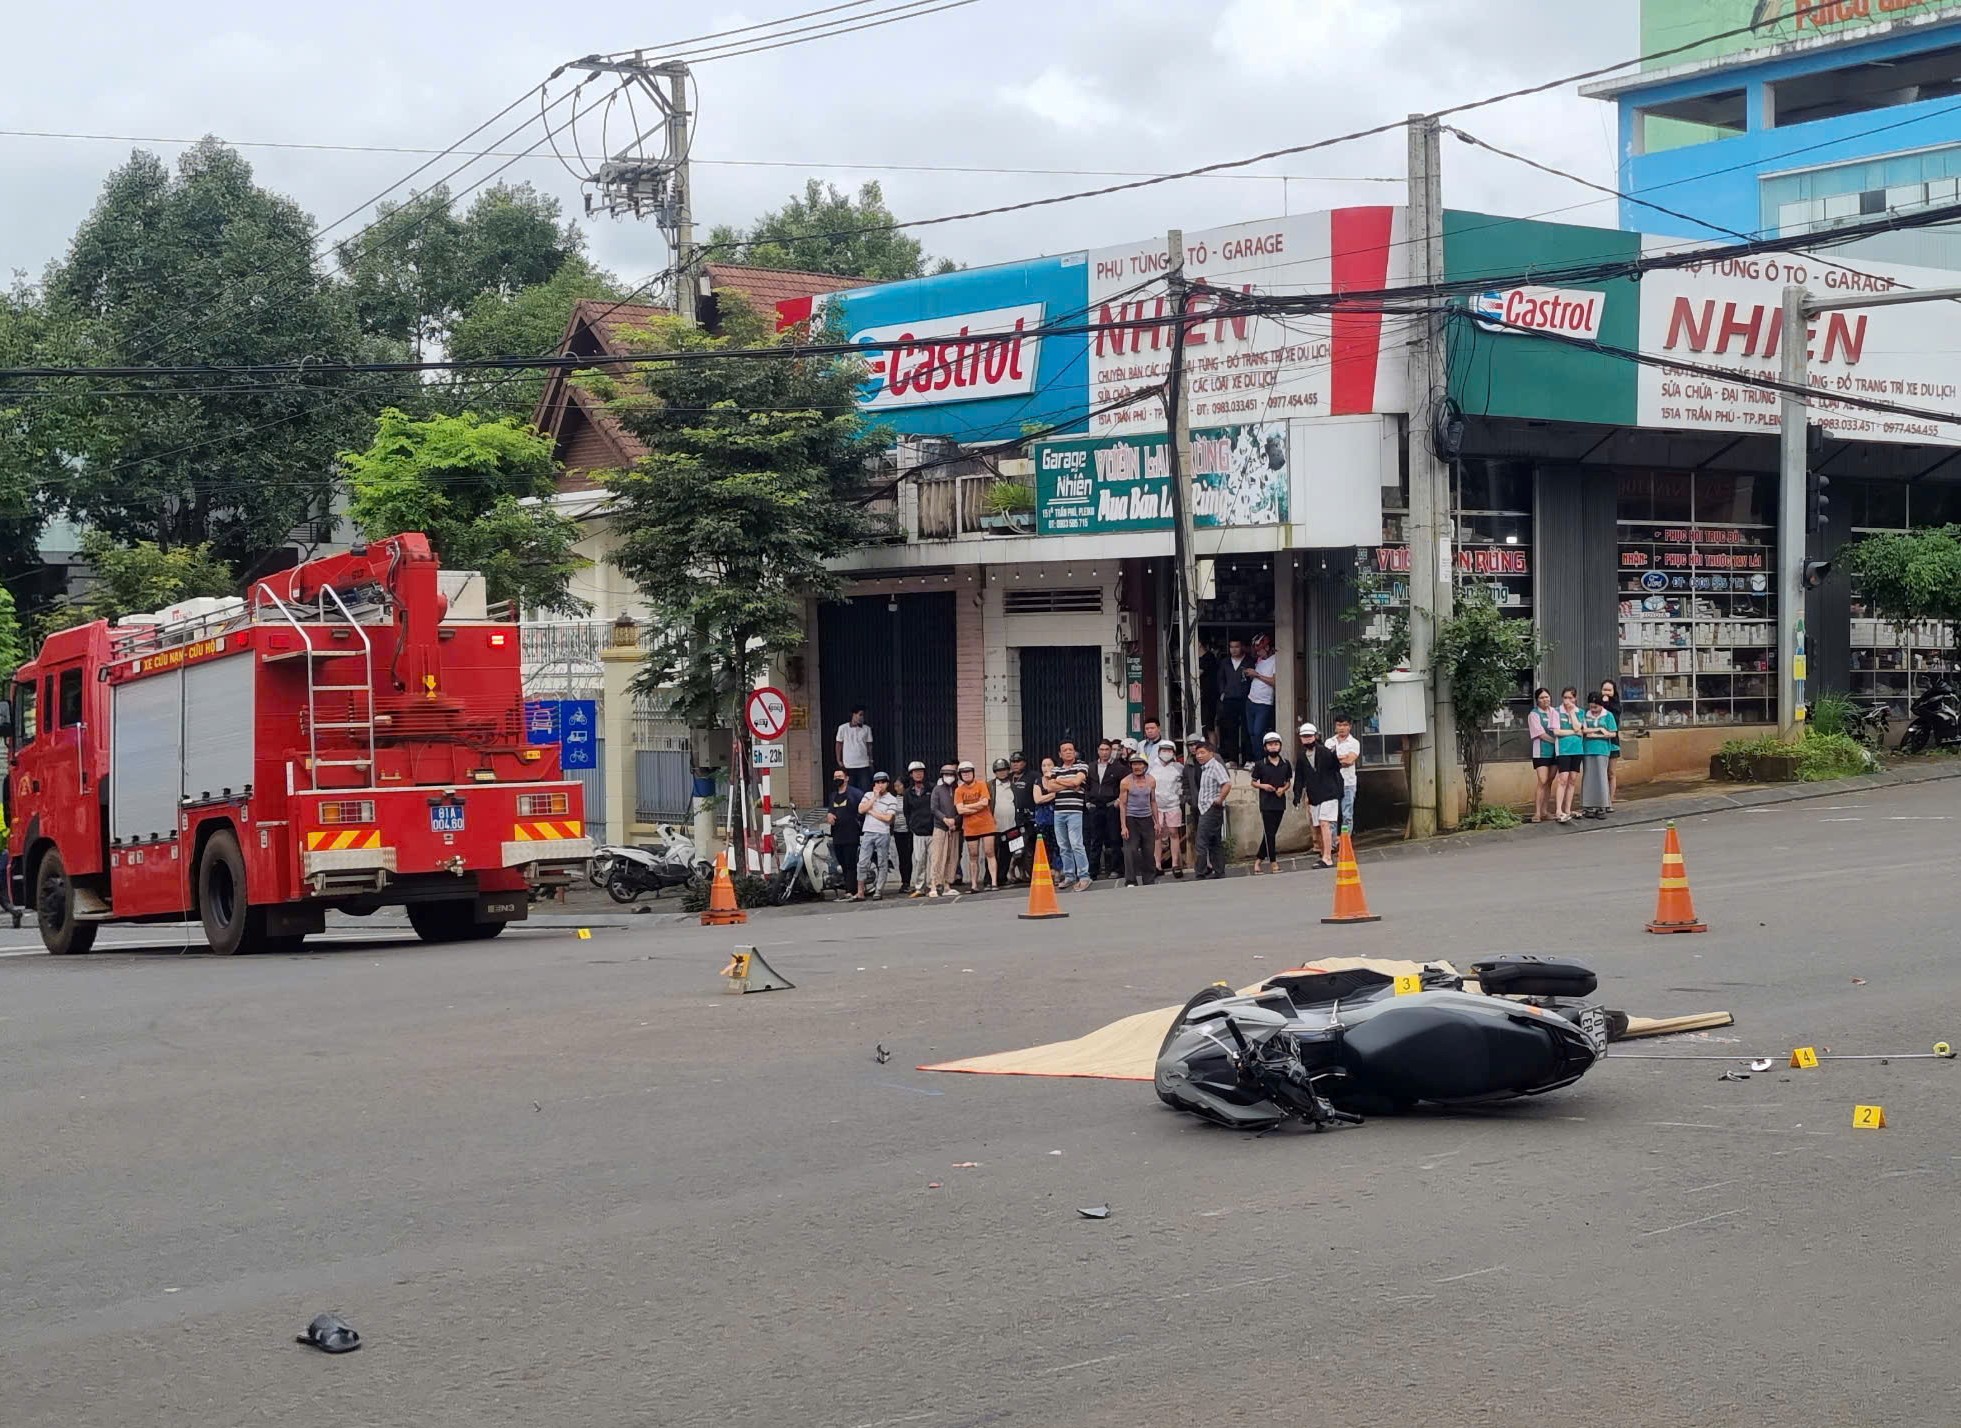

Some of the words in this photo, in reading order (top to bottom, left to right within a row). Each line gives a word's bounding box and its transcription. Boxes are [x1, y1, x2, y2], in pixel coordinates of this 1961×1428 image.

[1097, 261, 1123, 281] PHỤ
[1222, 233, 1284, 261] GARAGE
[1825, 270, 1895, 293] GARAGE
[1505, 290, 1595, 332] Castrol
[888, 317, 1025, 396] Castrol
[1232, 375, 1242, 390] XE
[1244, 373, 1257, 388] DU
[1661, 380, 1681, 398] SỬA
[1721, 387, 1739, 404] ĐẠI
[1742, 389, 1776, 405] TRUNG
[1855, 378, 1888, 393] TRANG
[1890, 378, 1904, 394] TRÍ
[1906, 381, 1918, 396] XE
[1920, 383, 1935, 397] DU
[1936, 384, 1957, 400] LỊCH
[1661, 407, 1681, 419] 151A
[1715, 408, 1735, 423] PHÚ
[1042, 448, 1087, 472] Garage
[1056, 472, 1092, 498] Nhiên
[1098, 488, 1129, 523] Mua
[1130, 483, 1158, 520] Bán
[1749, 553, 1762, 568] LÁI
[143, 658, 153, 671] XE
[154, 652, 168, 668] CỨU
[169, 649, 184, 665] NẠN
[188, 643, 204, 659] CỨU
[205, 639, 216, 655] HỘ
[753, 749, 763, 764] 5h
[769, 748, 782, 763] 23h
[438, 807, 456, 819] 81A
[1402, 977, 1411, 991] 3
[1803, 1051, 1811, 1062] 4
[1862, 1107, 1872, 1123] 2
